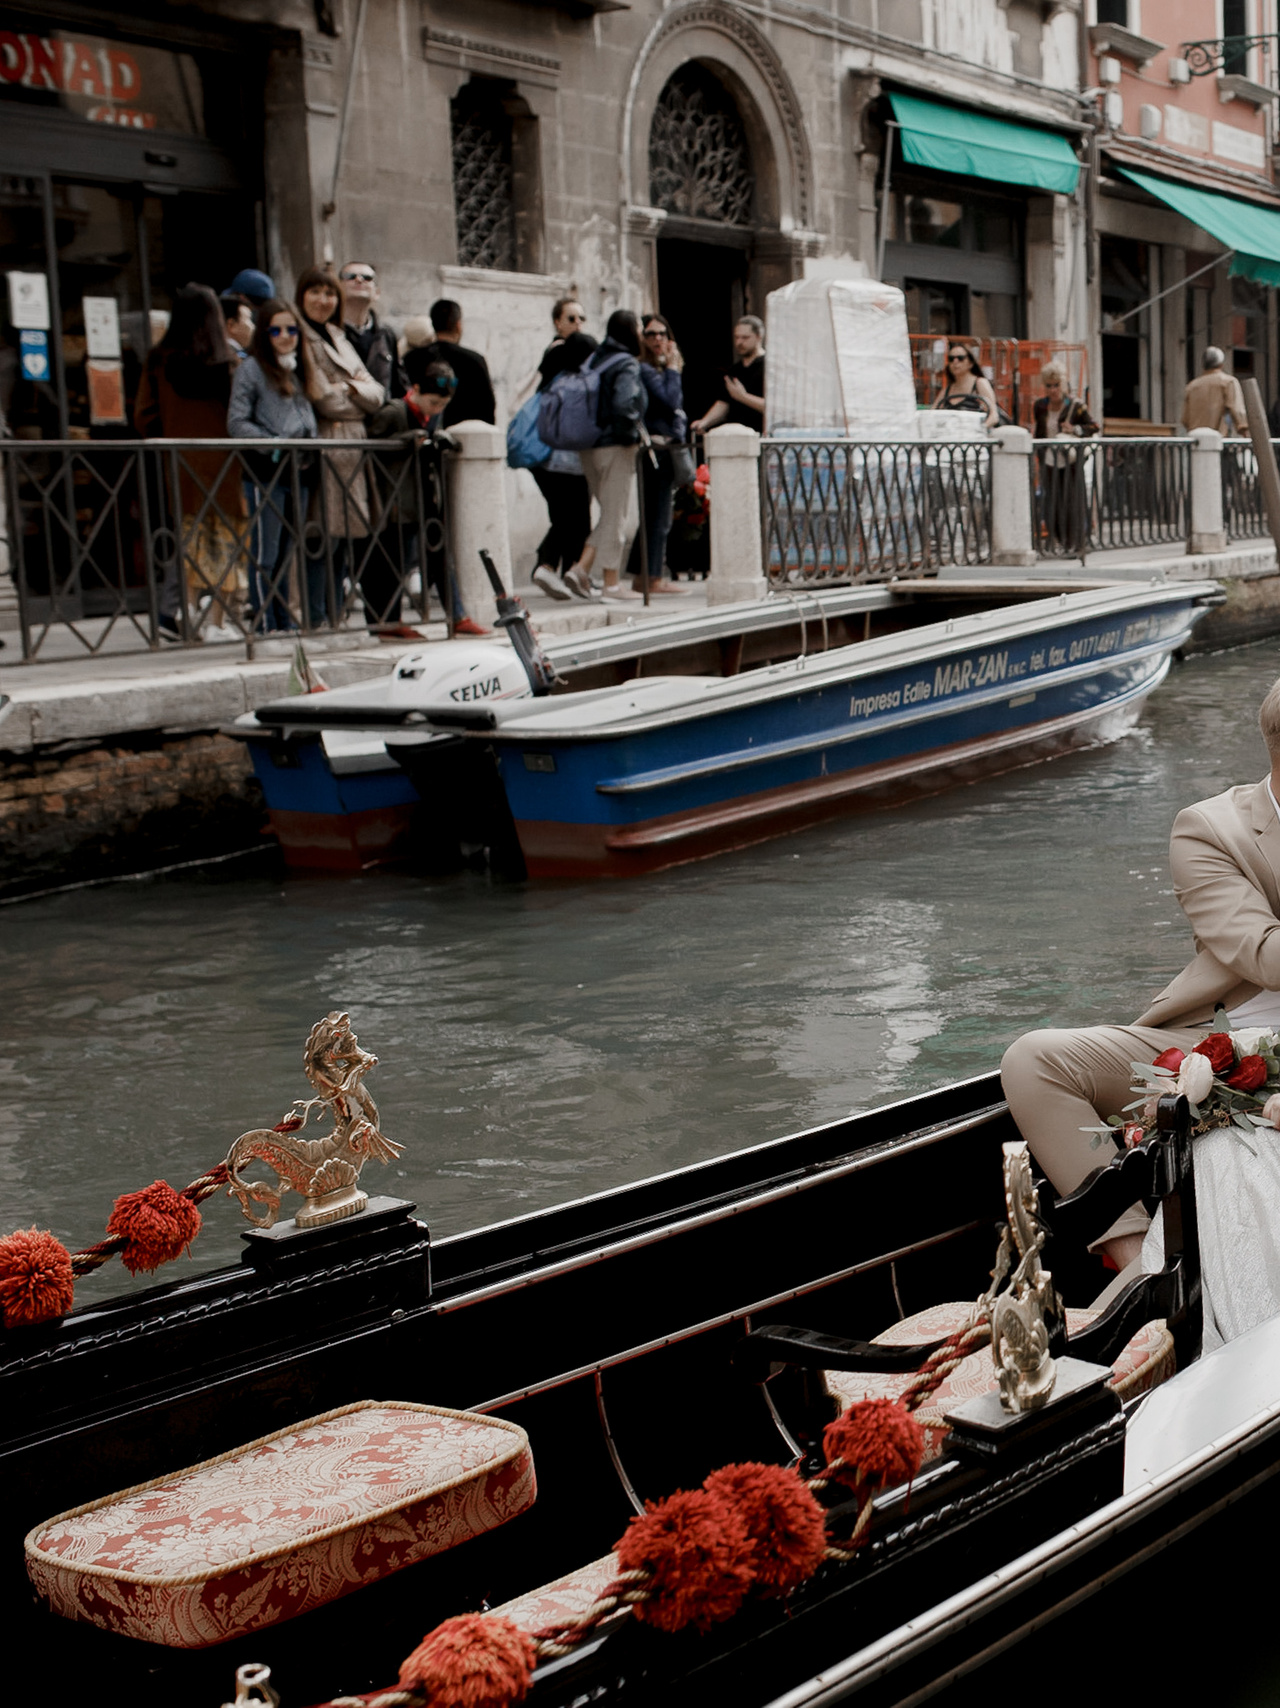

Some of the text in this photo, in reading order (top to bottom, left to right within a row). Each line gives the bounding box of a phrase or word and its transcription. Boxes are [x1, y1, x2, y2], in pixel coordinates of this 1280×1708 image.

[449, 676, 502, 702] SELVA
[850, 690, 901, 718] Impresa
[903, 680, 932, 704] Edile
[933, 650, 1009, 698] MAR-ZAN
